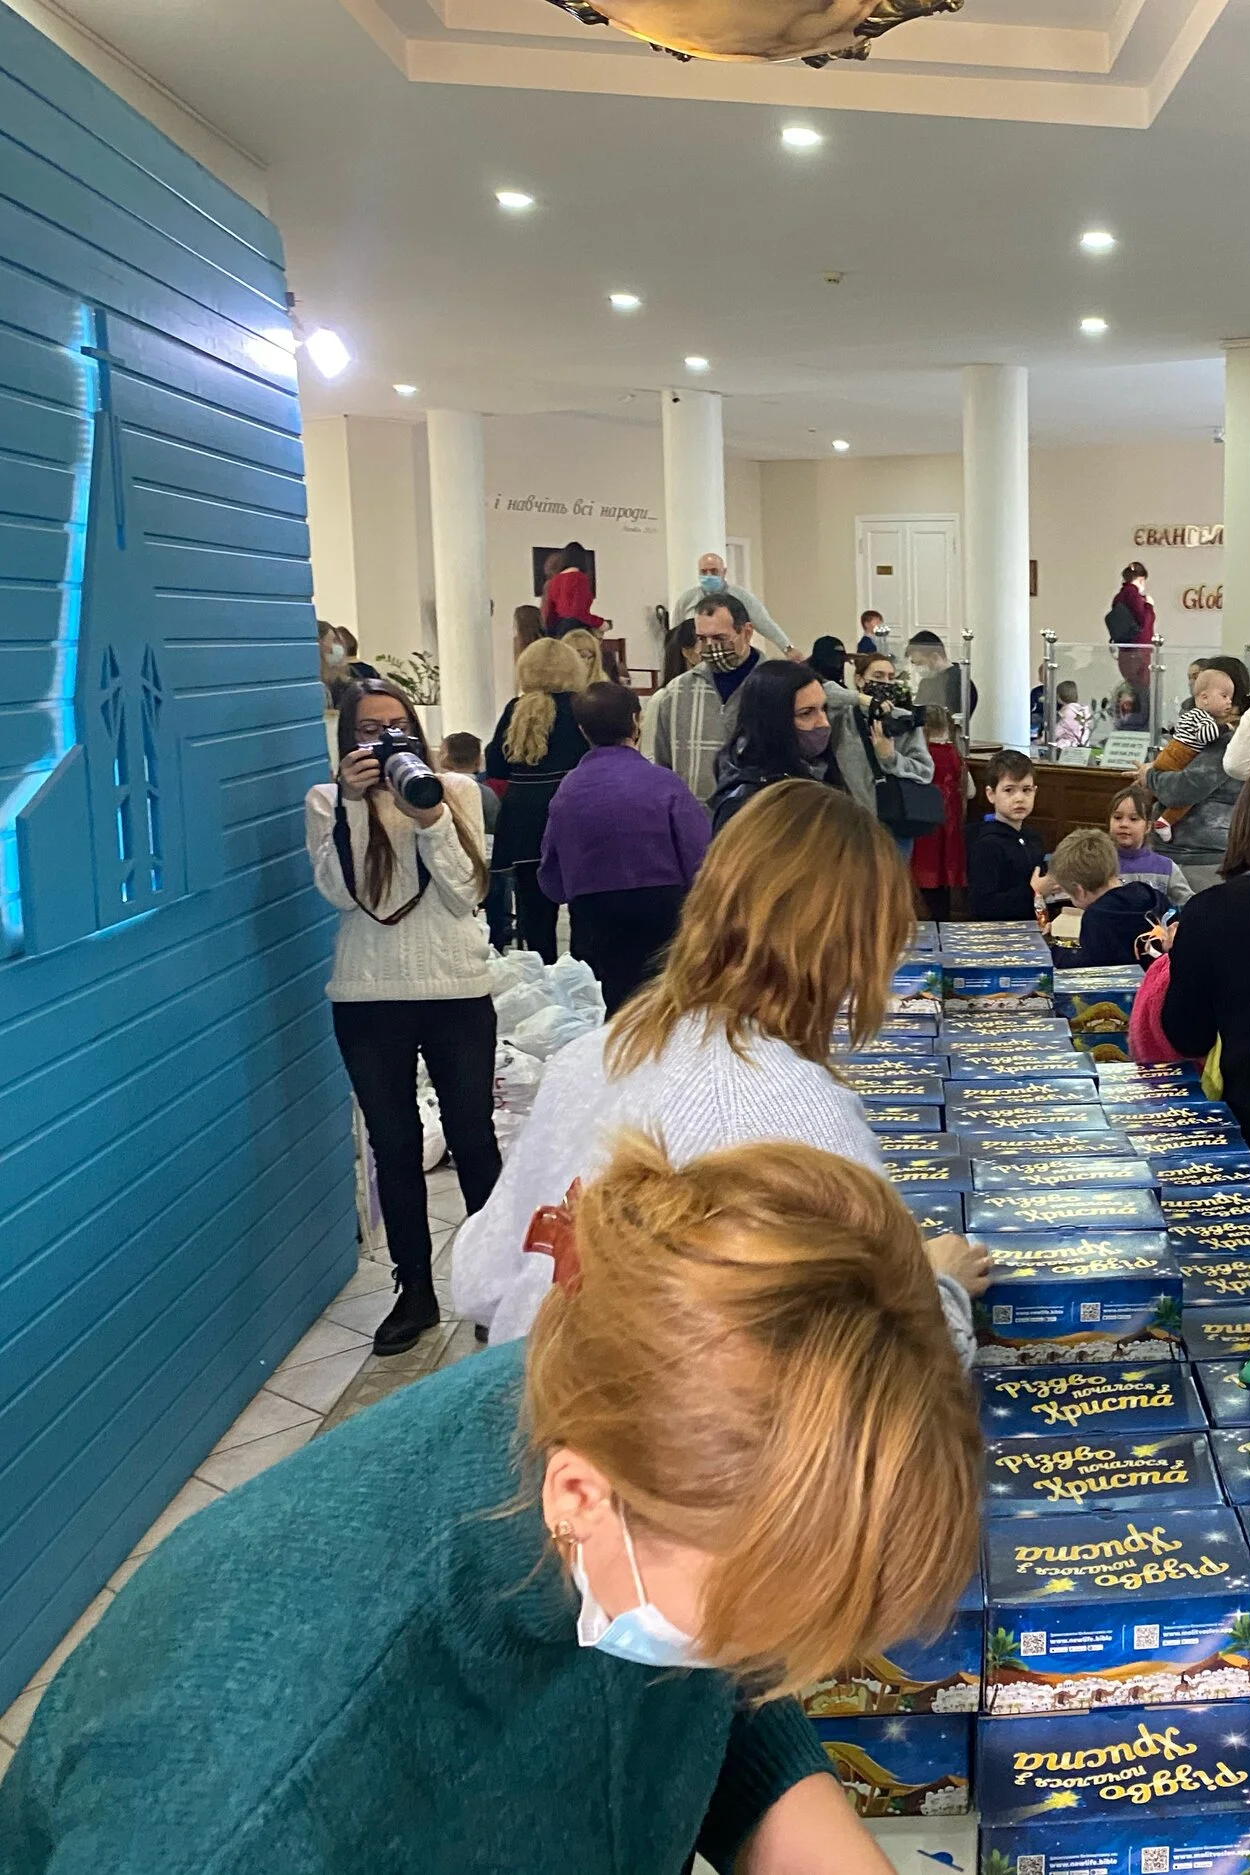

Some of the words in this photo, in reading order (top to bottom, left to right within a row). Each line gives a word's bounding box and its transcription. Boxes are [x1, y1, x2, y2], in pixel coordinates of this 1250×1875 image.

[507, 494, 568, 515] навчіть
[573, 498, 595, 516] всі
[1018, 1168, 1136, 1186] Христа
[1156, 1161, 1224, 1178] Хрис
[1014, 1205, 1138, 1224] Христа
[991, 1238, 1123, 1260] Христа
[1050, 1257, 1159, 1275] Різдво
[995, 1373, 1107, 1399] Різдво
[1071, 1382, 1156, 1399] почалося
[1157, 1383, 1170, 1394] з
[1031, 1393, 1175, 1427] Христа
[995, 1445, 1116, 1474] Різдво
[1077, 1458, 1169, 1475] почалося
[1170, 1459, 1185, 1470] з
[1032, 1469, 1189, 1505] Христа
[1014, 1523, 1183, 1562] Христа
[1034, 1558, 1137, 1576] почалося
[1094, 1555, 1229, 1590] Різдво
[1013, 1722, 1198, 1772] Христа
[1014, 1771, 1034, 1786] з
[1034, 1764, 1147, 1788] почалося
[1099, 1761, 1249, 1804] Різдво
